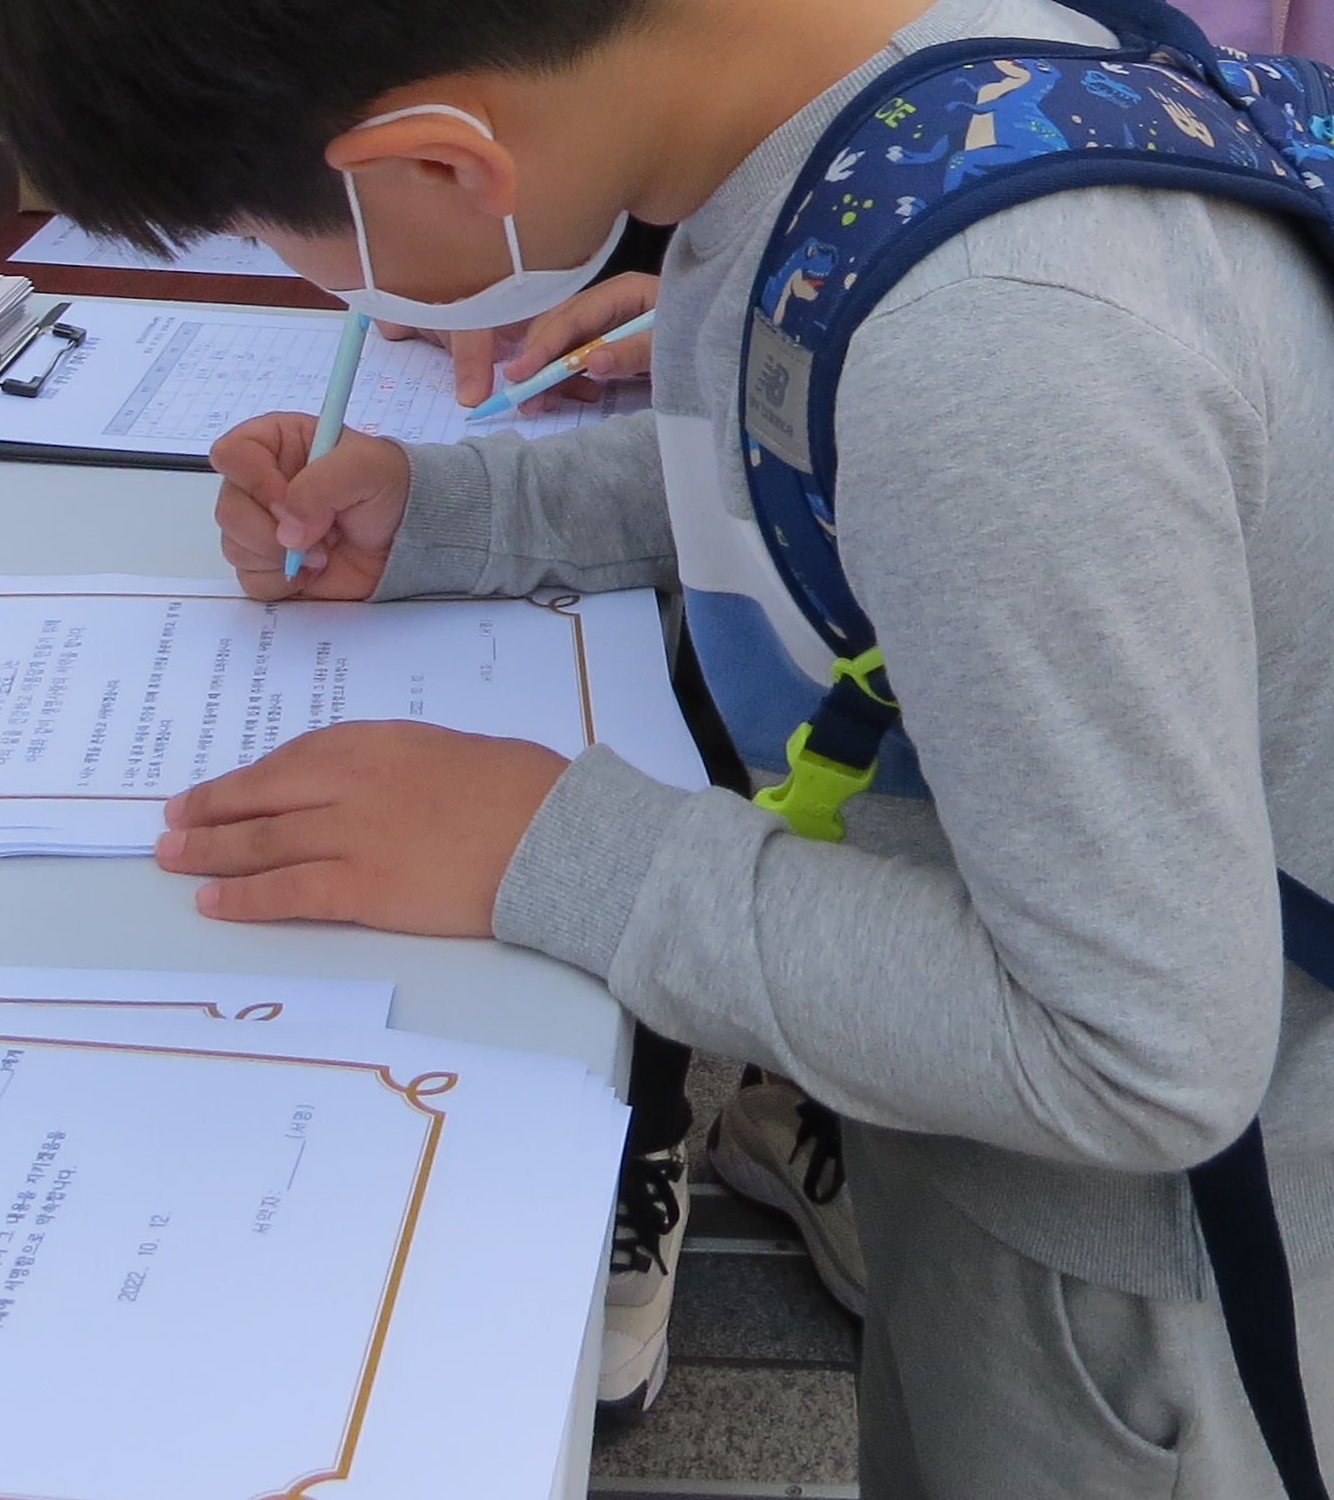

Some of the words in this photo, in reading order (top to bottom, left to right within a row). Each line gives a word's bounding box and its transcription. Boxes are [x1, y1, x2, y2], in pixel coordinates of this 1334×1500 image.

[5, 1190, 36, 1224] 내용을
[25, 1130, 66, 1183] 지키겠음을
[4, 1232, 45, 1291] 서명함으로
[136, 1238, 160, 1255] 10.
[148, 1211, 171, 1227] 12.
